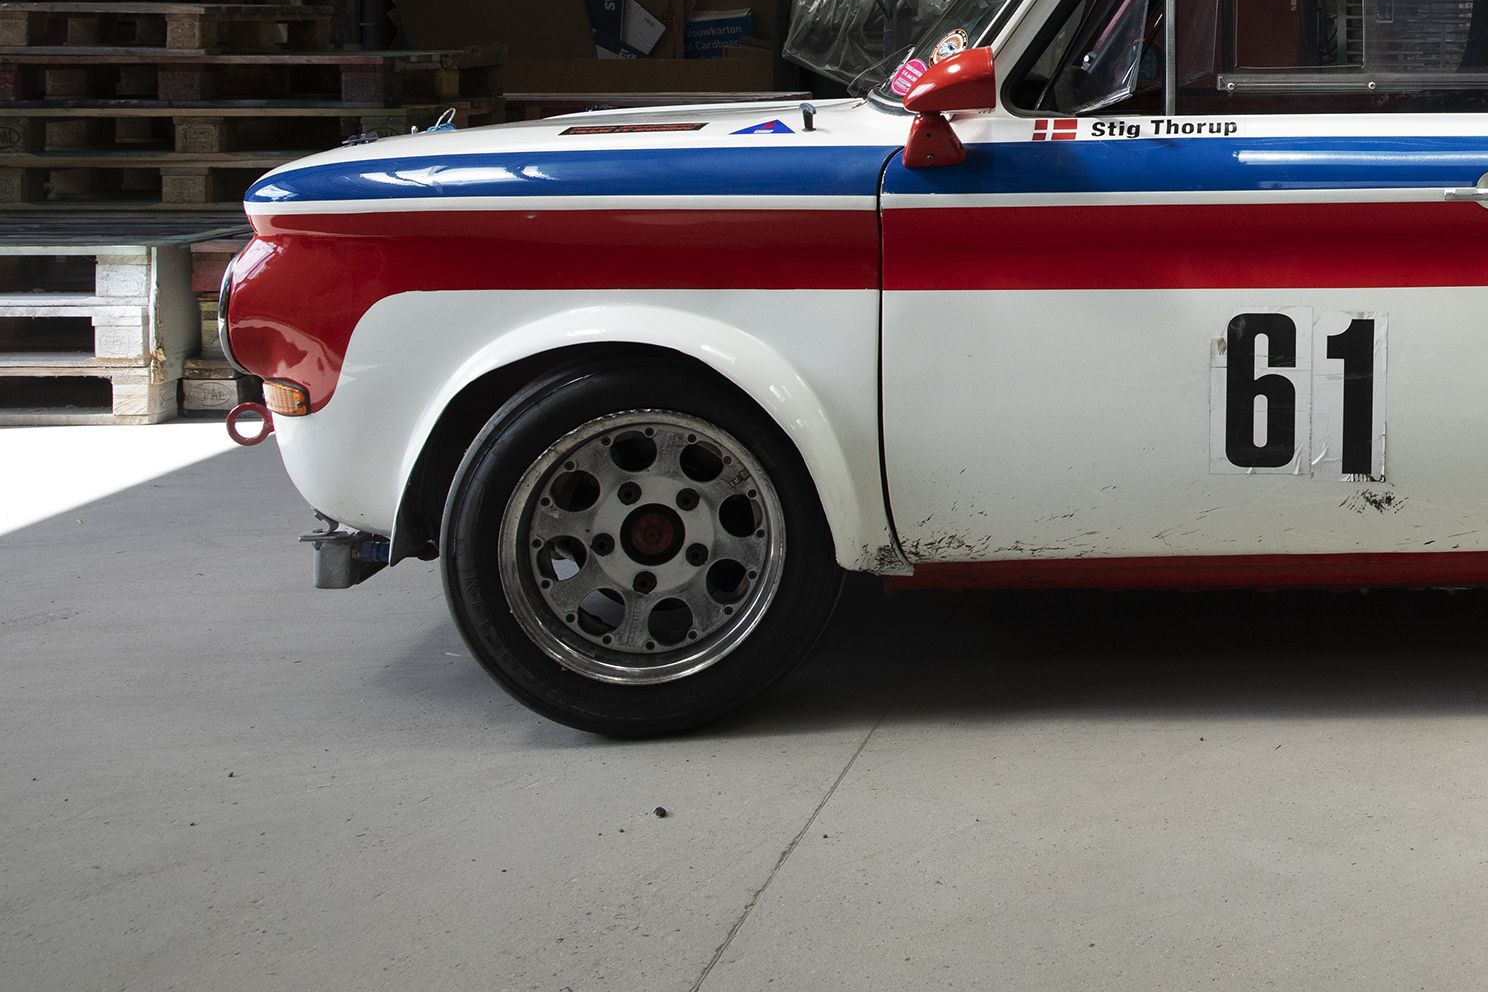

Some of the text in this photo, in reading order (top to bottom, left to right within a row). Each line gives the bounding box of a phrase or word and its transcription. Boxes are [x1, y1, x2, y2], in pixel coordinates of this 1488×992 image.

[1091, 119, 1238, 139] Stig Thorup
[1225, 313, 1375, 475] 61
